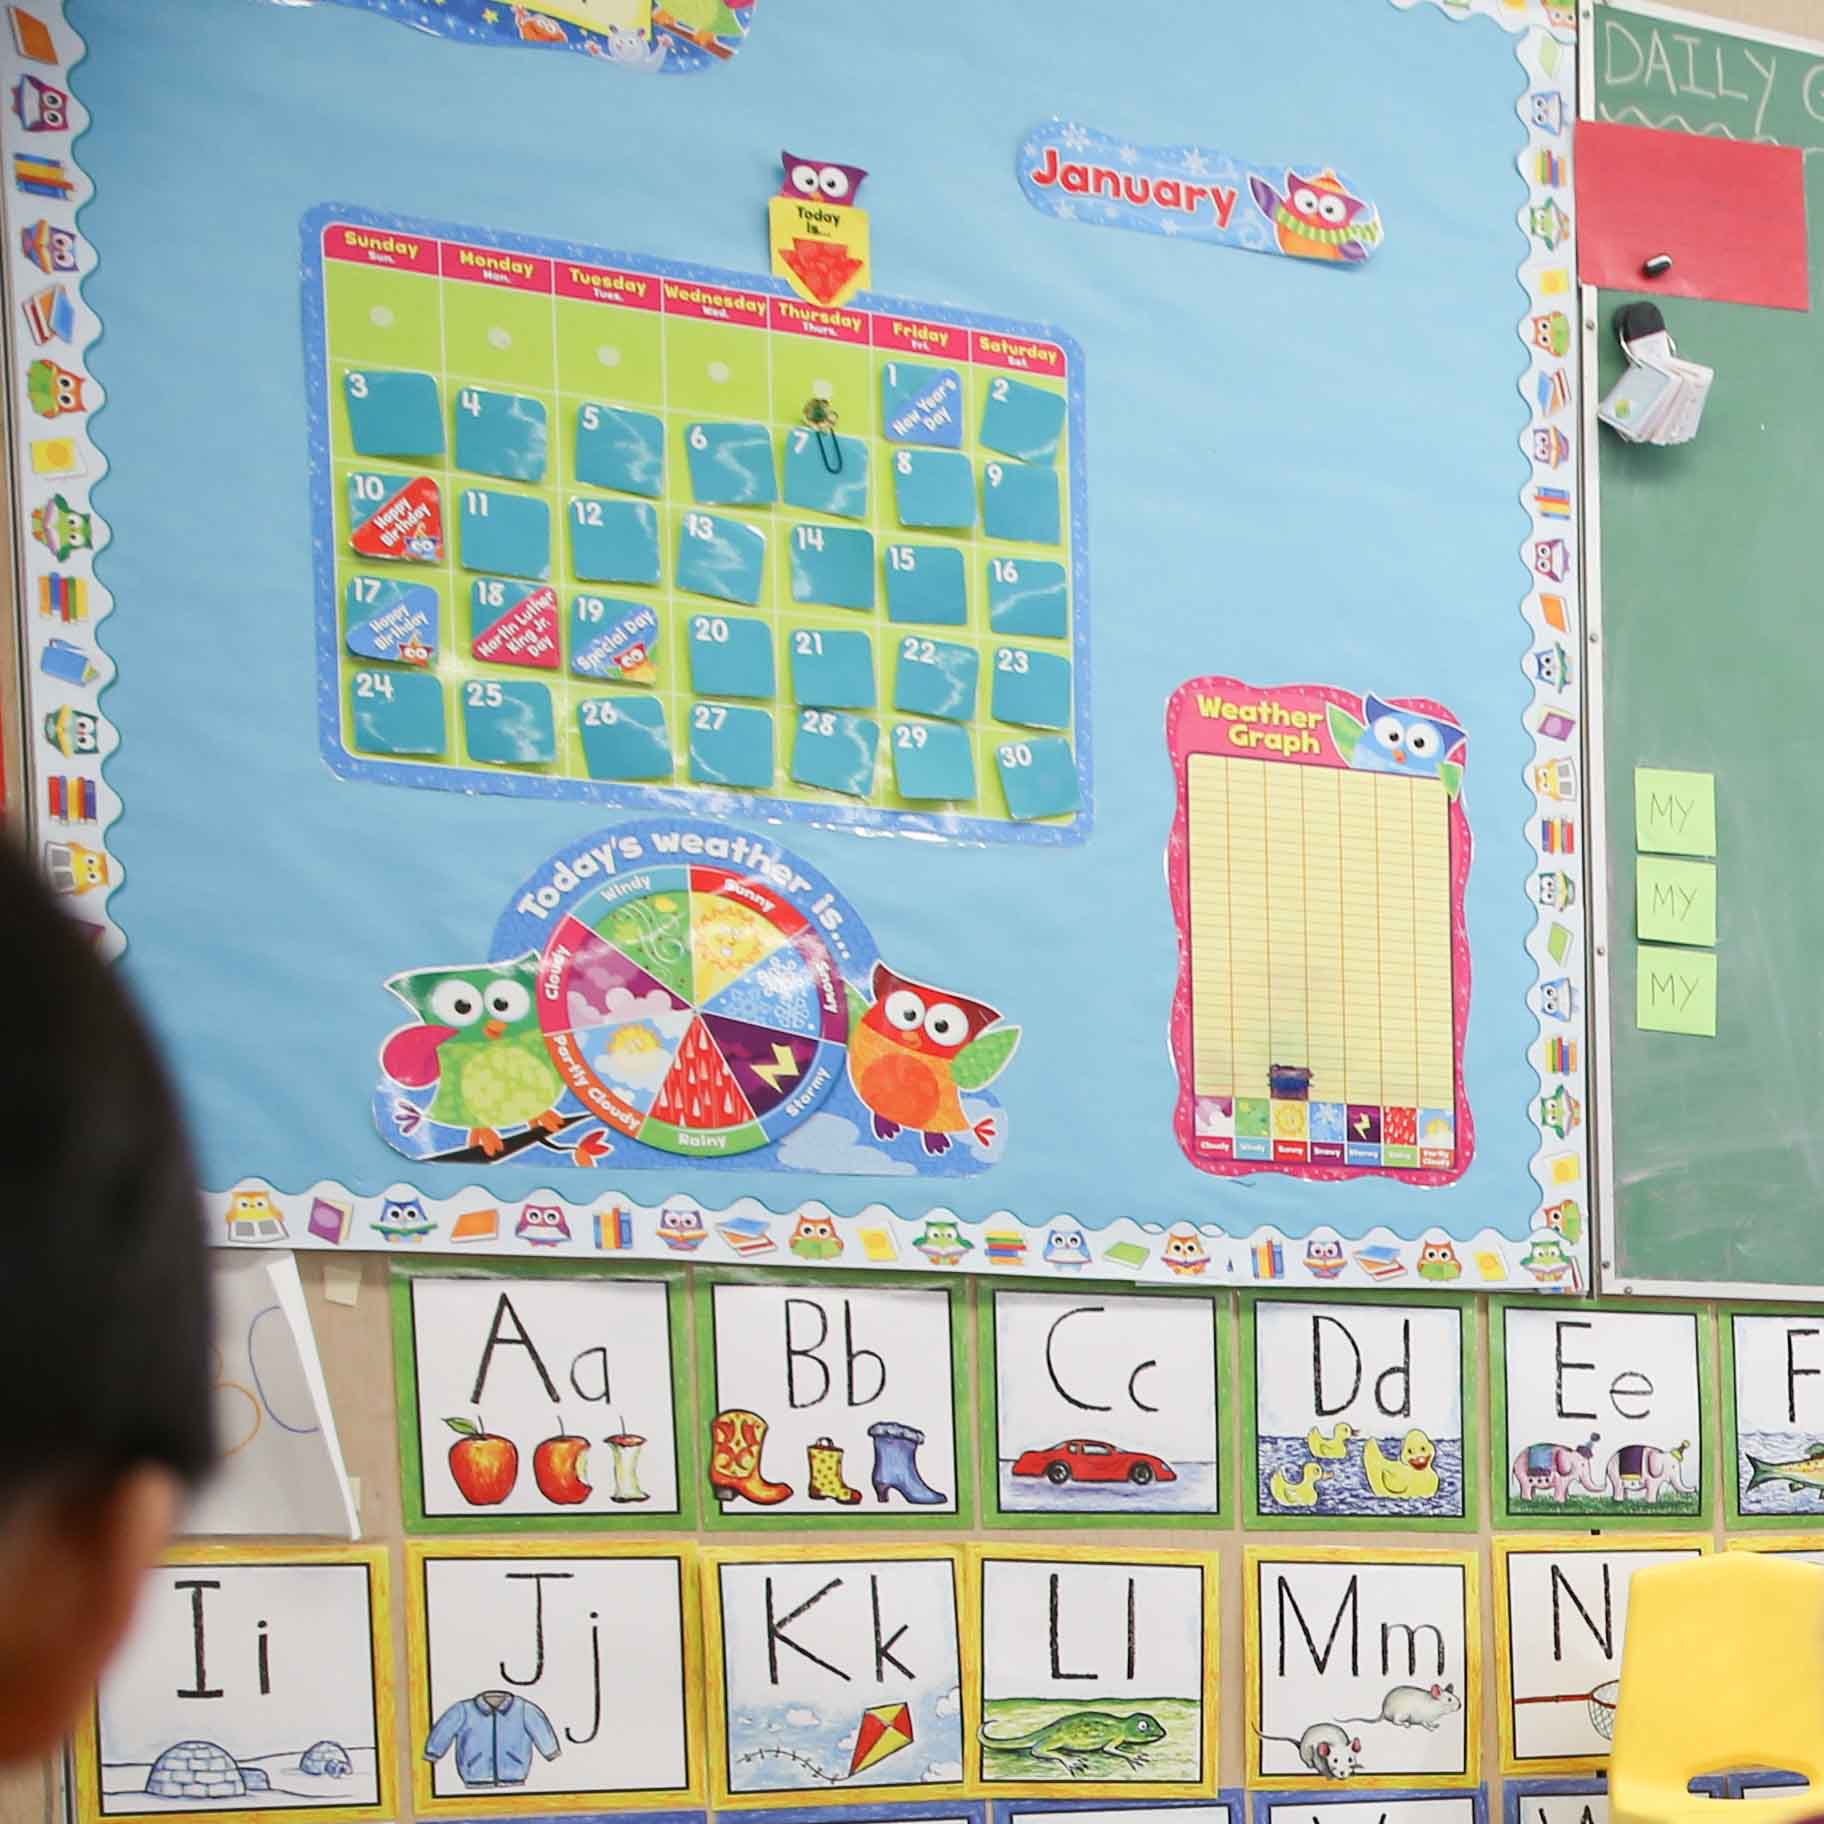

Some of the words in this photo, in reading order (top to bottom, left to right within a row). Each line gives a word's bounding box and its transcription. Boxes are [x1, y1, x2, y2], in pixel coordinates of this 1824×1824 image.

[1605, 21, 1777, 134] DAILY
[1031, 148, 1236, 229] January
[796, 206, 840, 227] Today
[344, 231, 419, 259] Sunday
[459, 250, 534, 278] Monday
[569, 267, 647, 297] Tuesday
[664, 283, 767, 317] Wednesday
[778, 303, 862, 333] Thursday
[893, 322, 949, 346] Friday
[979, 337, 1058, 364] Saturday
[350, 374, 368, 398] 3
[887, 364, 898, 388] 1
[461, 391, 481, 416] 4
[992, 378, 1009, 402] 2
[582, 406, 599, 430] 5
[892, 409, 920, 436] New
[916, 378, 957, 412] Year's
[922, 406, 952, 432] Day
[690, 426, 707, 449] 6
[793, 430, 809, 454] 7
[896, 451, 912, 475] 8
[987, 464, 1003, 487] 9
[354, 475, 384, 500] 10
[373, 497, 413, 529] Happy
[467, 492, 488, 517] 11
[575, 502, 603, 527] 12
[380, 503, 432, 547] Birthday
[687, 513, 714, 540] 13
[796, 527, 825, 551] 14
[889, 547, 915, 571] 15
[992, 560, 1018, 583] 16
[353, 578, 381, 603] 17
[477, 581, 505, 607] 18
[369, 604, 410, 632] Happy
[577, 597, 604, 622] 19
[374, 612, 429, 651] Birthday
[477, 621, 519, 657] Martin
[515, 592, 554, 627] Luther
[507, 630, 538, 655] King
[534, 616, 551, 632] Jr.
[695, 618, 728, 642] 20
[528, 635, 554, 657] Day
[577, 625, 627, 671] Special
[625, 609, 657, 635] Day
[795, 632, 823, 655] 21
[903, 638, 936, 664] 22
[998, 650, 1029, 673] 23
[356, 674, 394, 699] 24
[467, 682, 503, 707] 25
[582, 700, 617, 726] 26
[695, 707, 727, 731] 27
[801, 710, 838, 736] 28
[1196, 694, 1324, 729] Weather
[896, 725, 927, 750] 29
[1228, 722, 1321, 757] Graph
[998, 745, 1032, 769] 30
[517, 832, 643, 920] Today's
[651, 832, 812, 894] weather
[812, 893, 850, 960] is...
[599, 875, 652, 903] Windy
[724, 879, 775, 913] Sunny
[549, 944, 572, 1001] Cloudy
[552, 1035, 589, 1088] Partly
[587, 1086, 640, 1131] Cloudy
[786, 1066, 831, 1117] Stormy
[677, 1133, 727, 1149] Rainy
[470, 1292, 612, 1404] Aa
[785, 1299, 886, 1408] Bb
[1046, 1306, 1159, 1412] Cc
[1312, 1315, 1411, 1419] Dd
[1555, 1320, 1655, 1420] Ee
[174, 1580, 272, 1699] Ii
[766, 1575, 916, 1685] Kk
[1049, 1573, 1136, 1681] Ll
[1277, 1574, 1447, 1678] Mm
[498, 1572, 601, 1745] Jj
